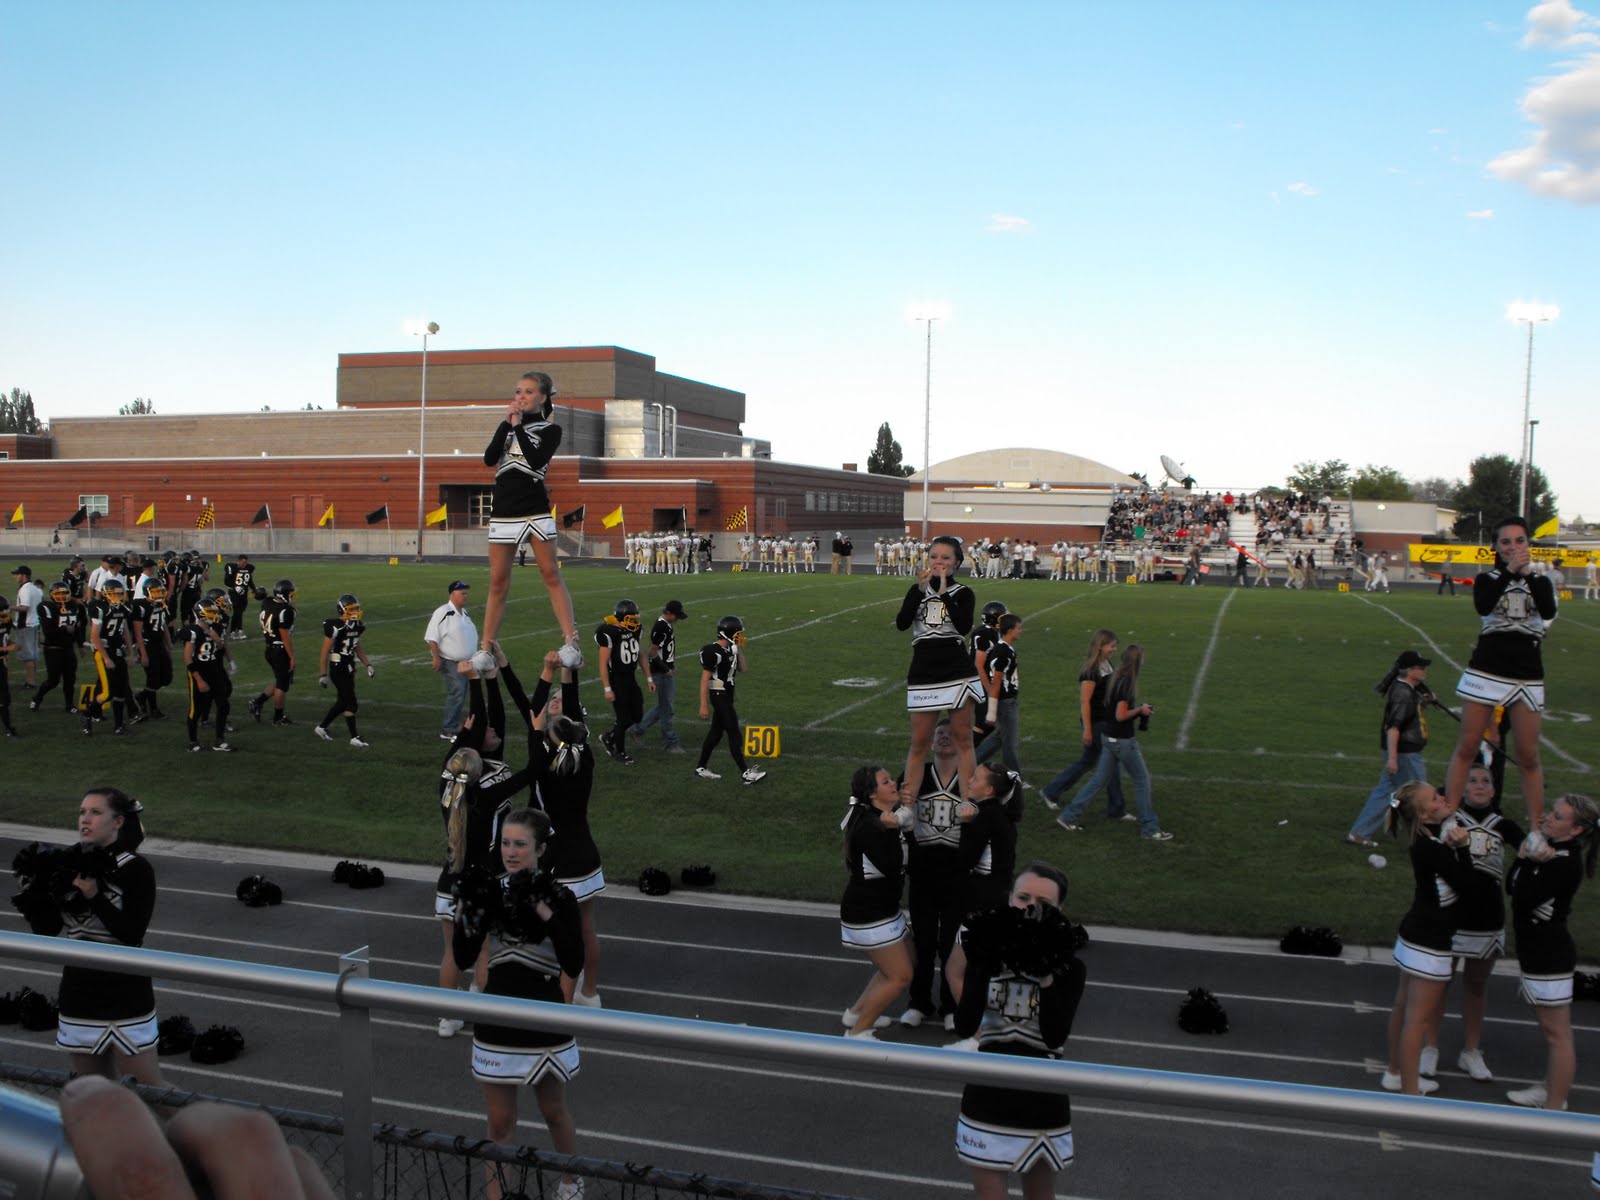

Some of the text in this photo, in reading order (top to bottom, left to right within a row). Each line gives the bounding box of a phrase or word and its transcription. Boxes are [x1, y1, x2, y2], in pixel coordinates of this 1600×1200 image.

[620, 637, 640, 665] 69
[747, 727, 776, 756] 50
[917, 799, 960, 829] EH
[1468, 831, 1502, 857] HS
